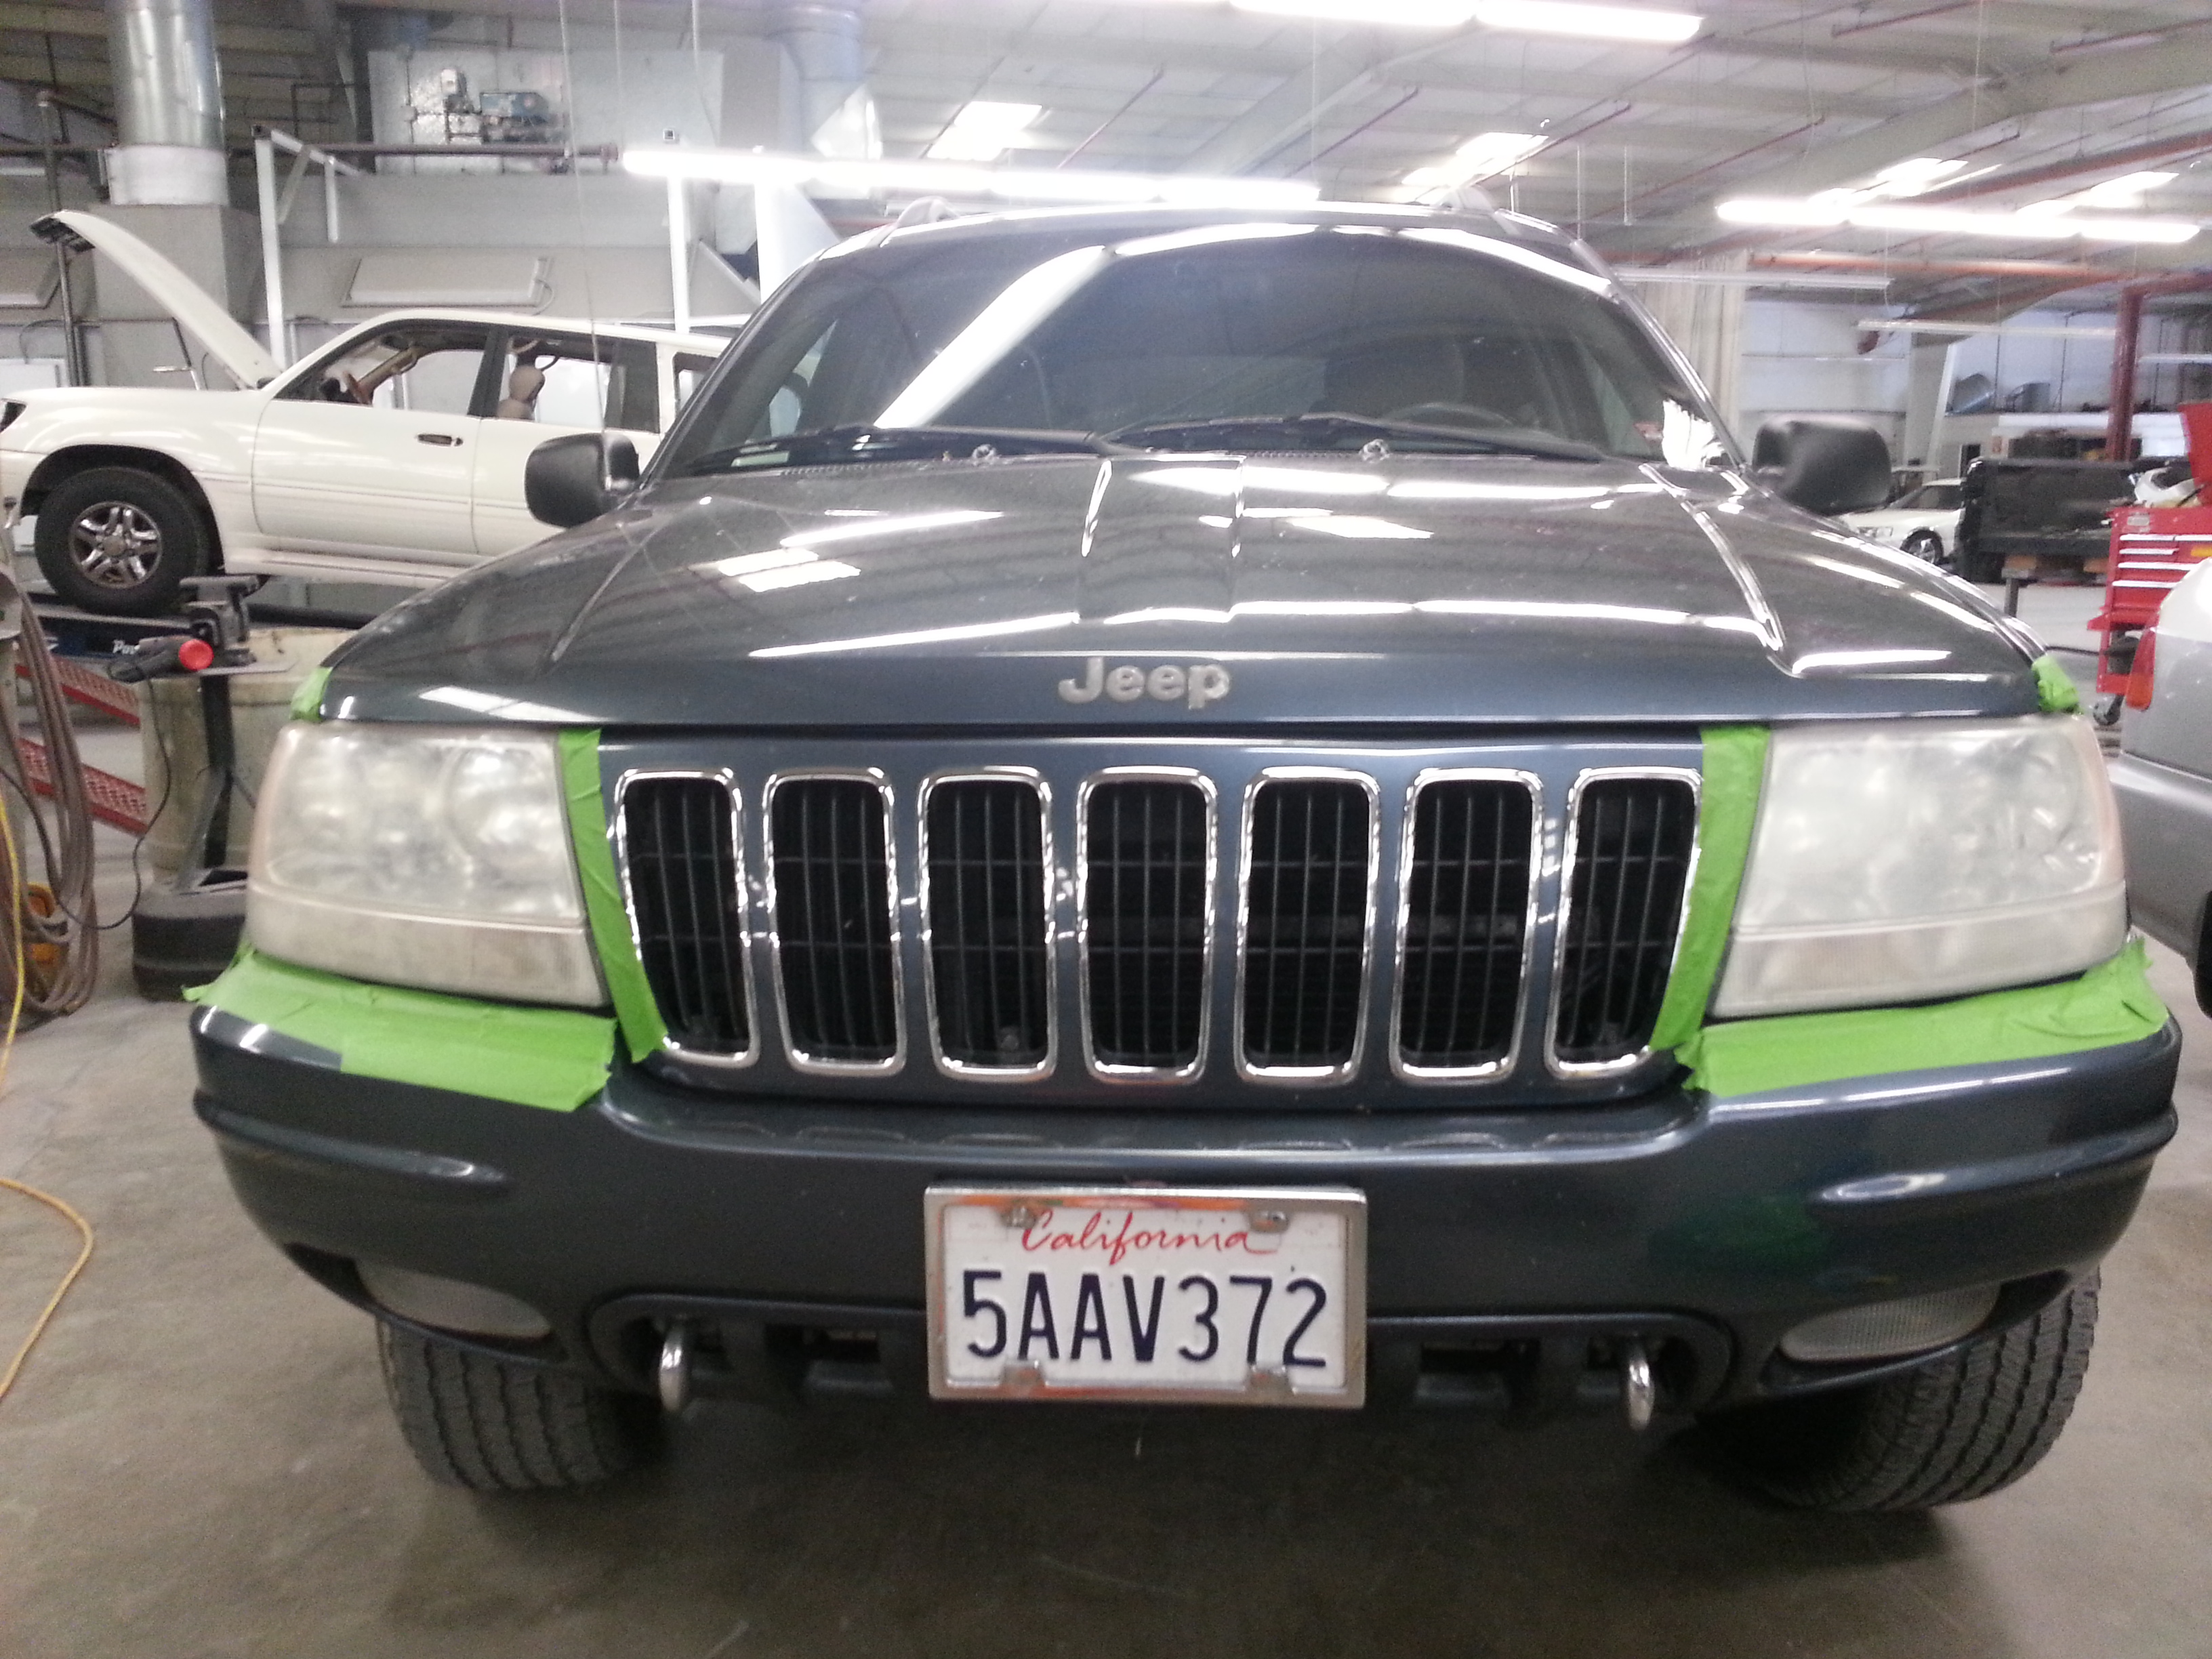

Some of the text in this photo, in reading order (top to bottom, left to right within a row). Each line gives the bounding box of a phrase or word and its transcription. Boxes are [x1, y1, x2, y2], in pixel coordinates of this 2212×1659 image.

[1058, 657, 1230, 710] Jeep
[1021, 1210, 1277, 1265] California
[962, 1269, 1327, 1368] 5AAV372
